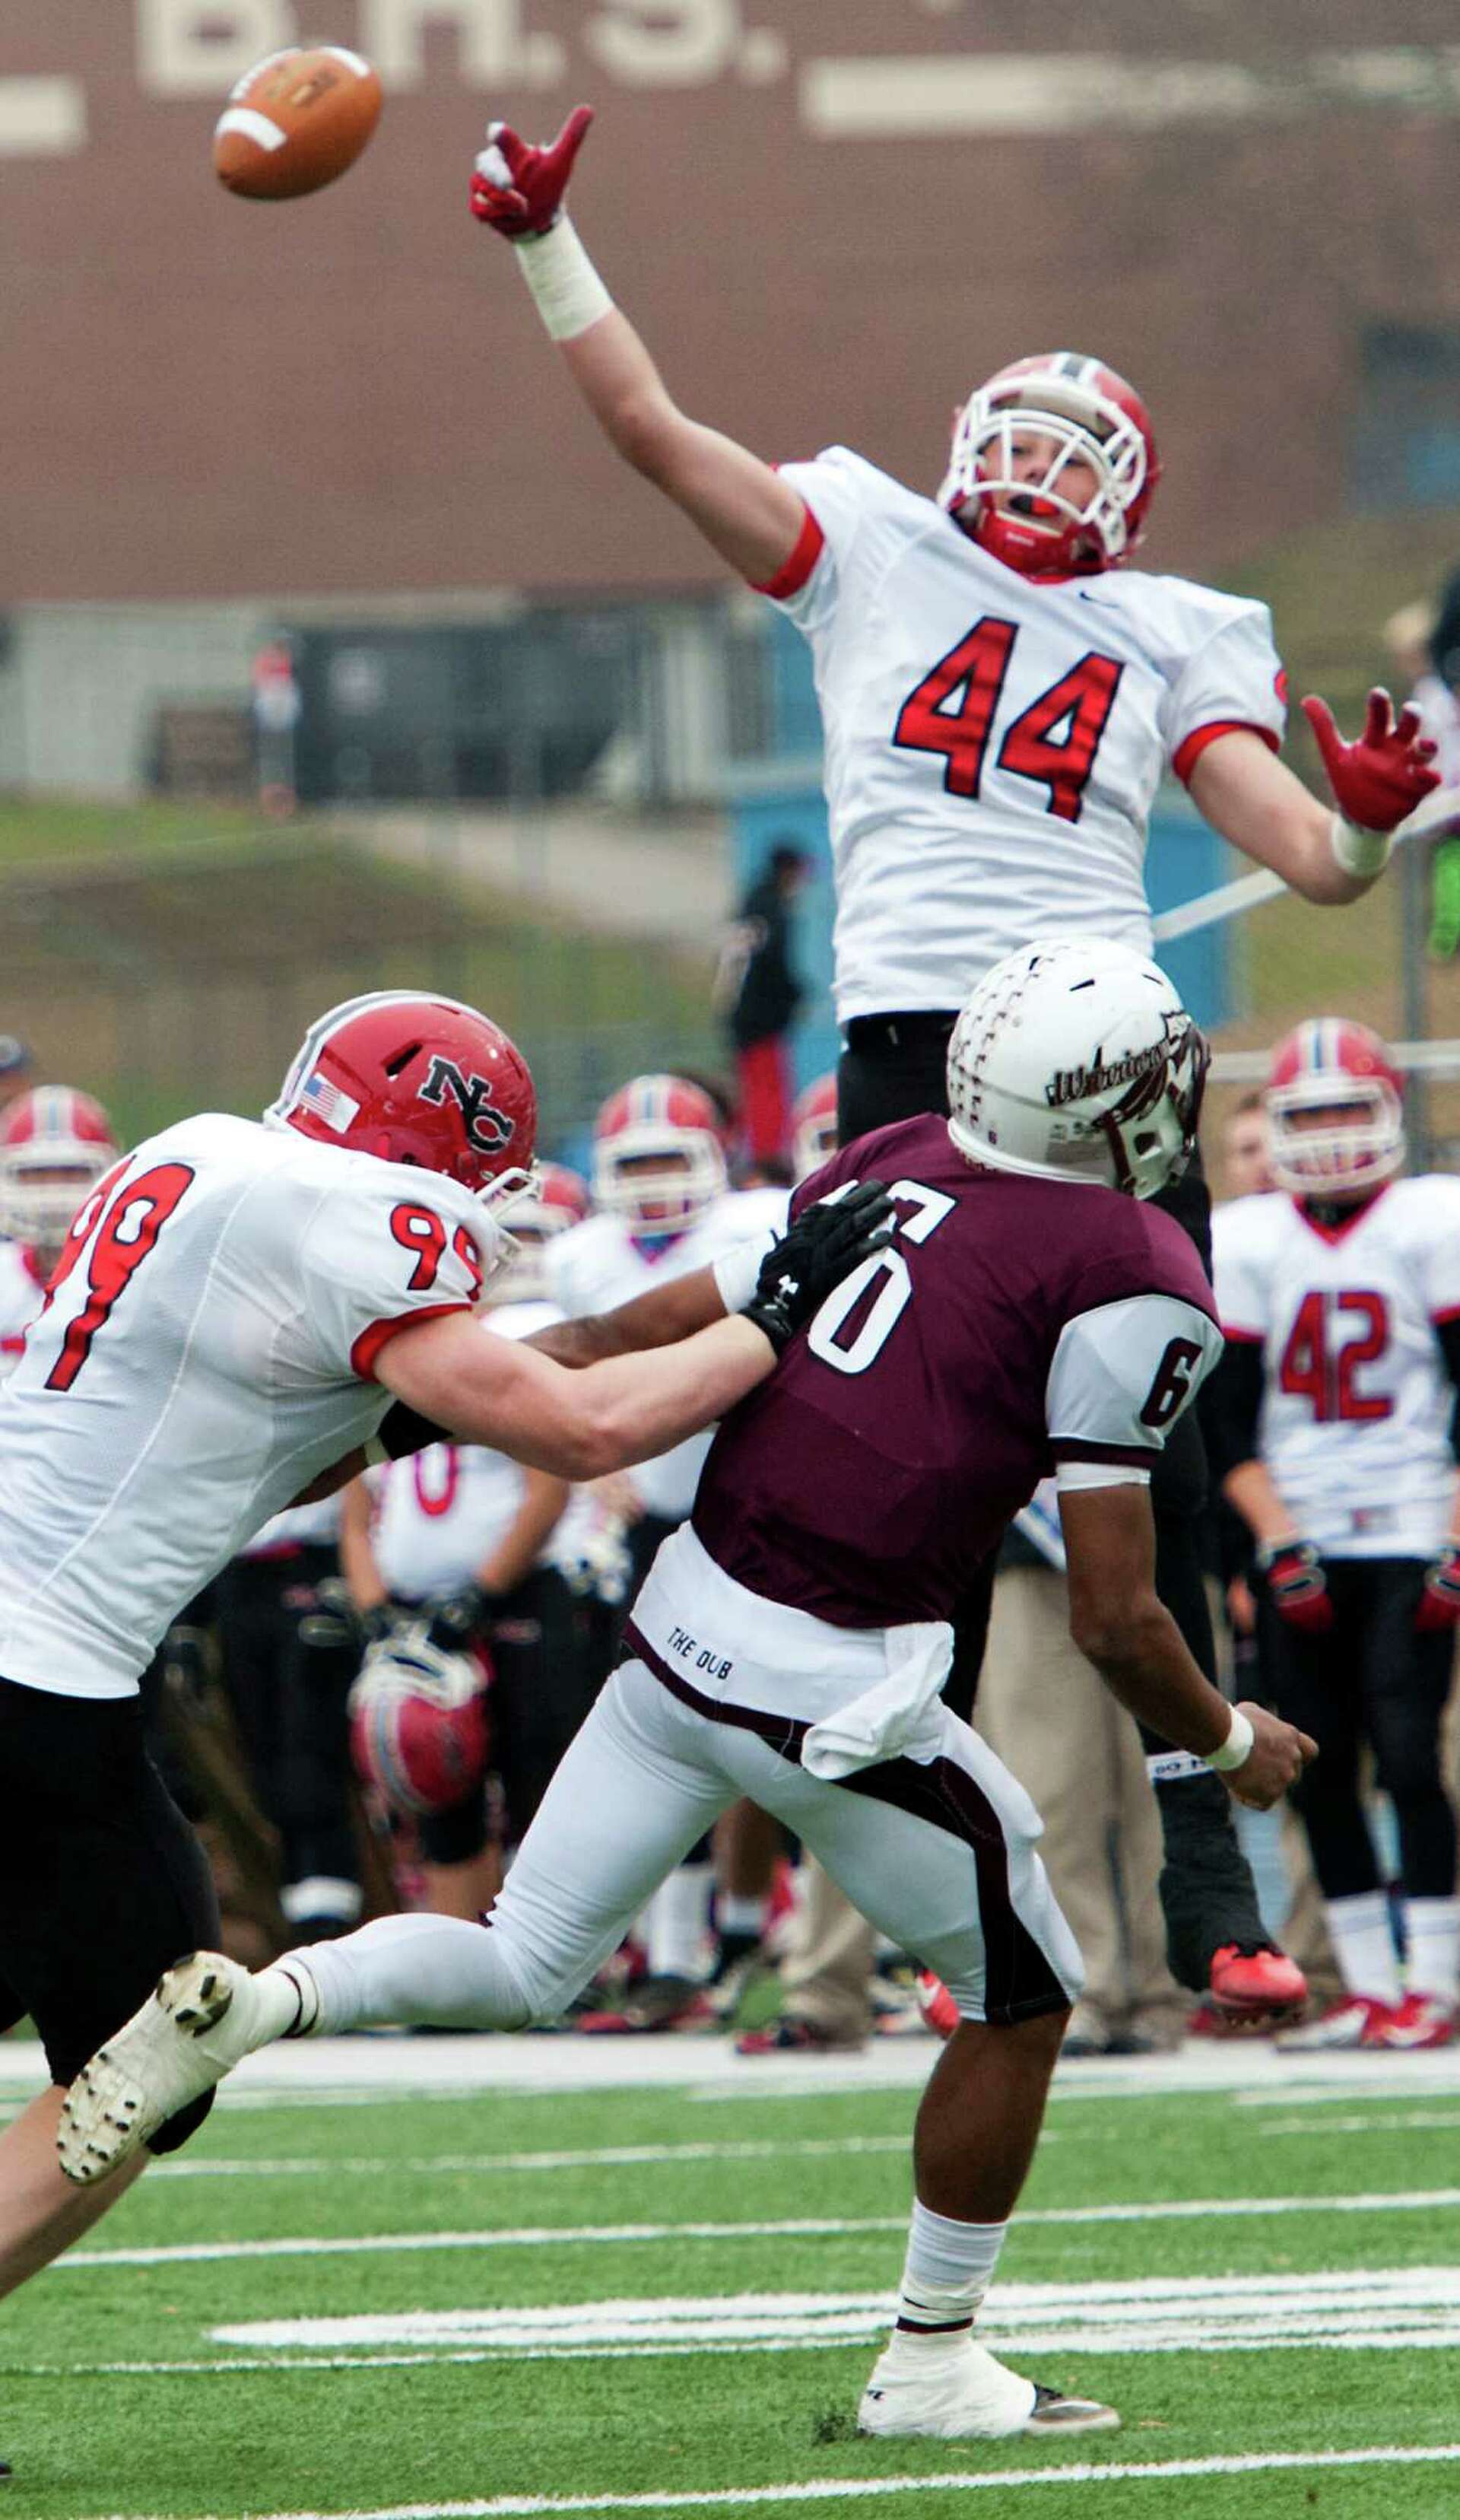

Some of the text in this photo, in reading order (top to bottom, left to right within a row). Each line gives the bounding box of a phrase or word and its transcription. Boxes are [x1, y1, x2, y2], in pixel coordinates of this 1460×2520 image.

[139, 0, 787, 93] BH.S.
[893, 615, 1125, 822] 44
[417, 1054, 516, 1155] NC
[1141, 1337, 1202, 1426] 6
[1280, 1289, 1395, 1424] 42
[668, 1626, 697, 1657] THE
